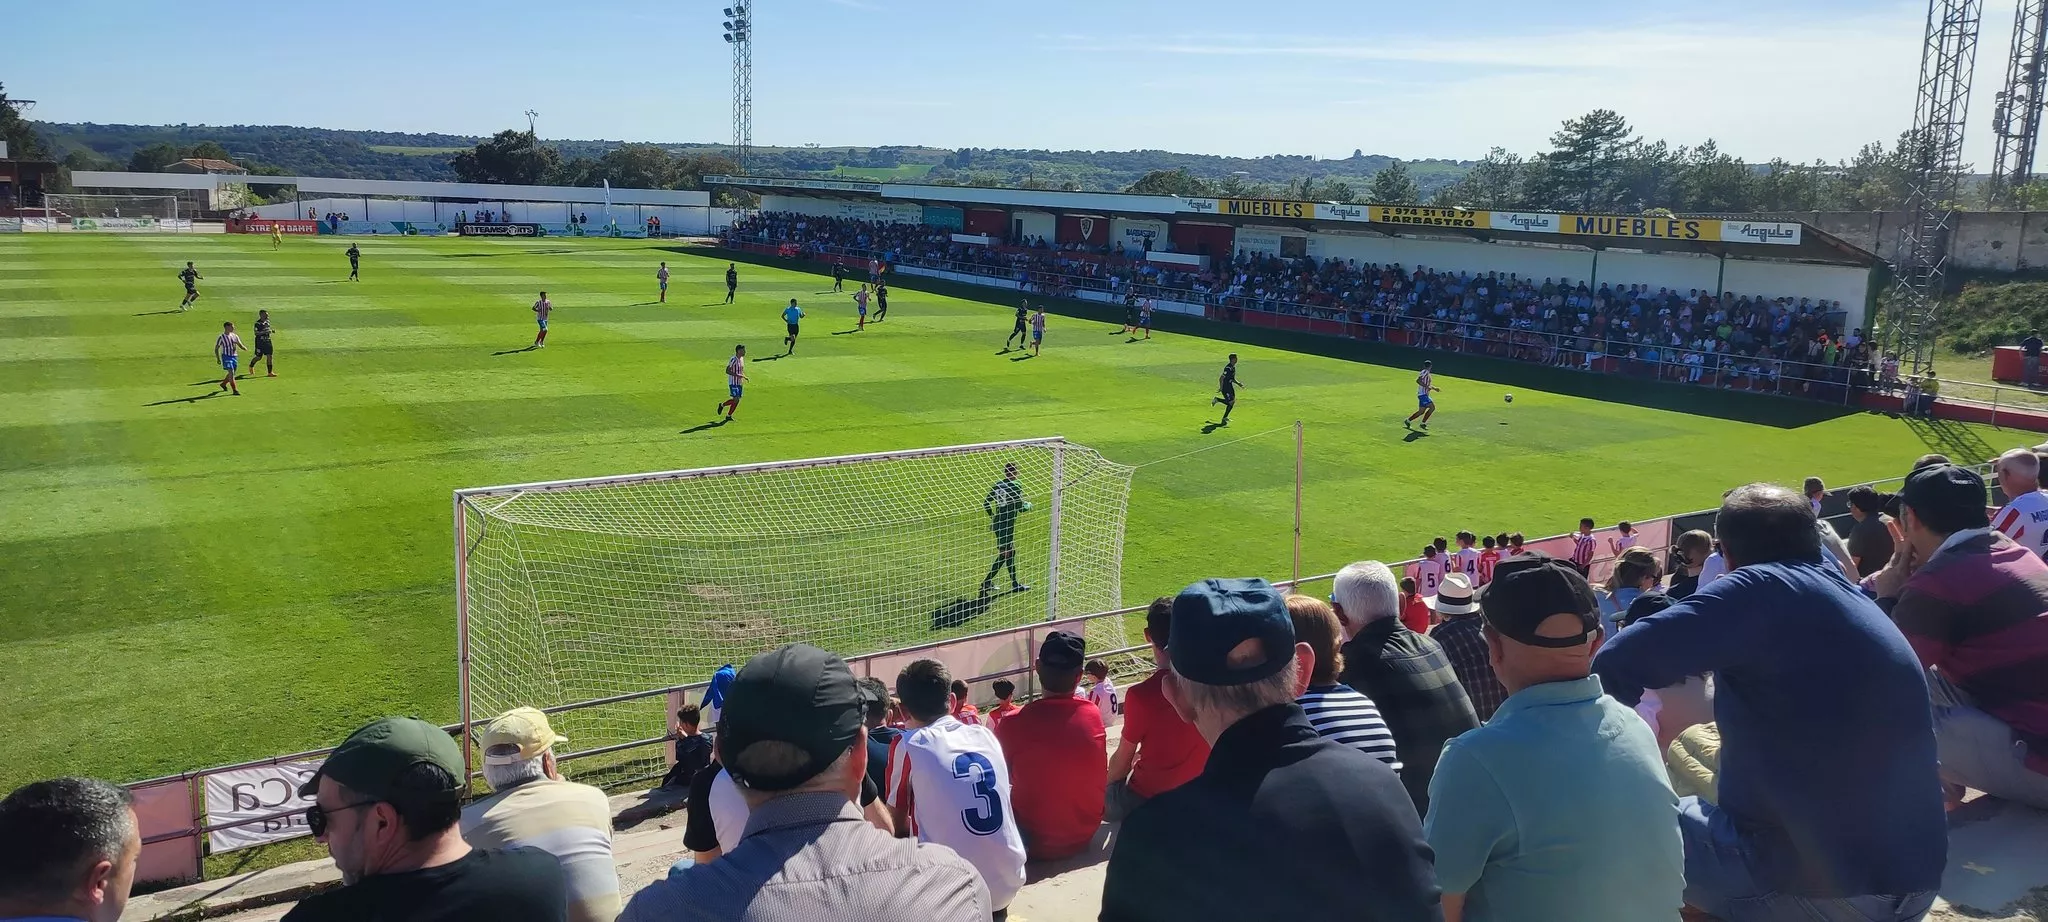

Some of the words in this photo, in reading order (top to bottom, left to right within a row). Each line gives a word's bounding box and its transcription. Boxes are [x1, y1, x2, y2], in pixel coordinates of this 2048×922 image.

[1228, 200, 1303, 217] MUEBLES
[1395, 207, 1418, 216] 974
[1423, 209, 1436, 217] 31
[1440, 210, 1455, 218] 18
[1460, 211, 1475, 219] 77
[245, 224, 286, 233] ESTREA
[287, 224, 313, 233] DAMM
[1381, 215, 1475, 227] BARBASTRO
[1575, 216, 1700, 240] MUEBLES
[1444, 559, 1451, 573] 6
[1466, 559, 1475, 575] 4
[1427, 572, 1436, 588] 5
[1110, 692, 1118, 714] 8
[952, 751, 1004, 836] 3
